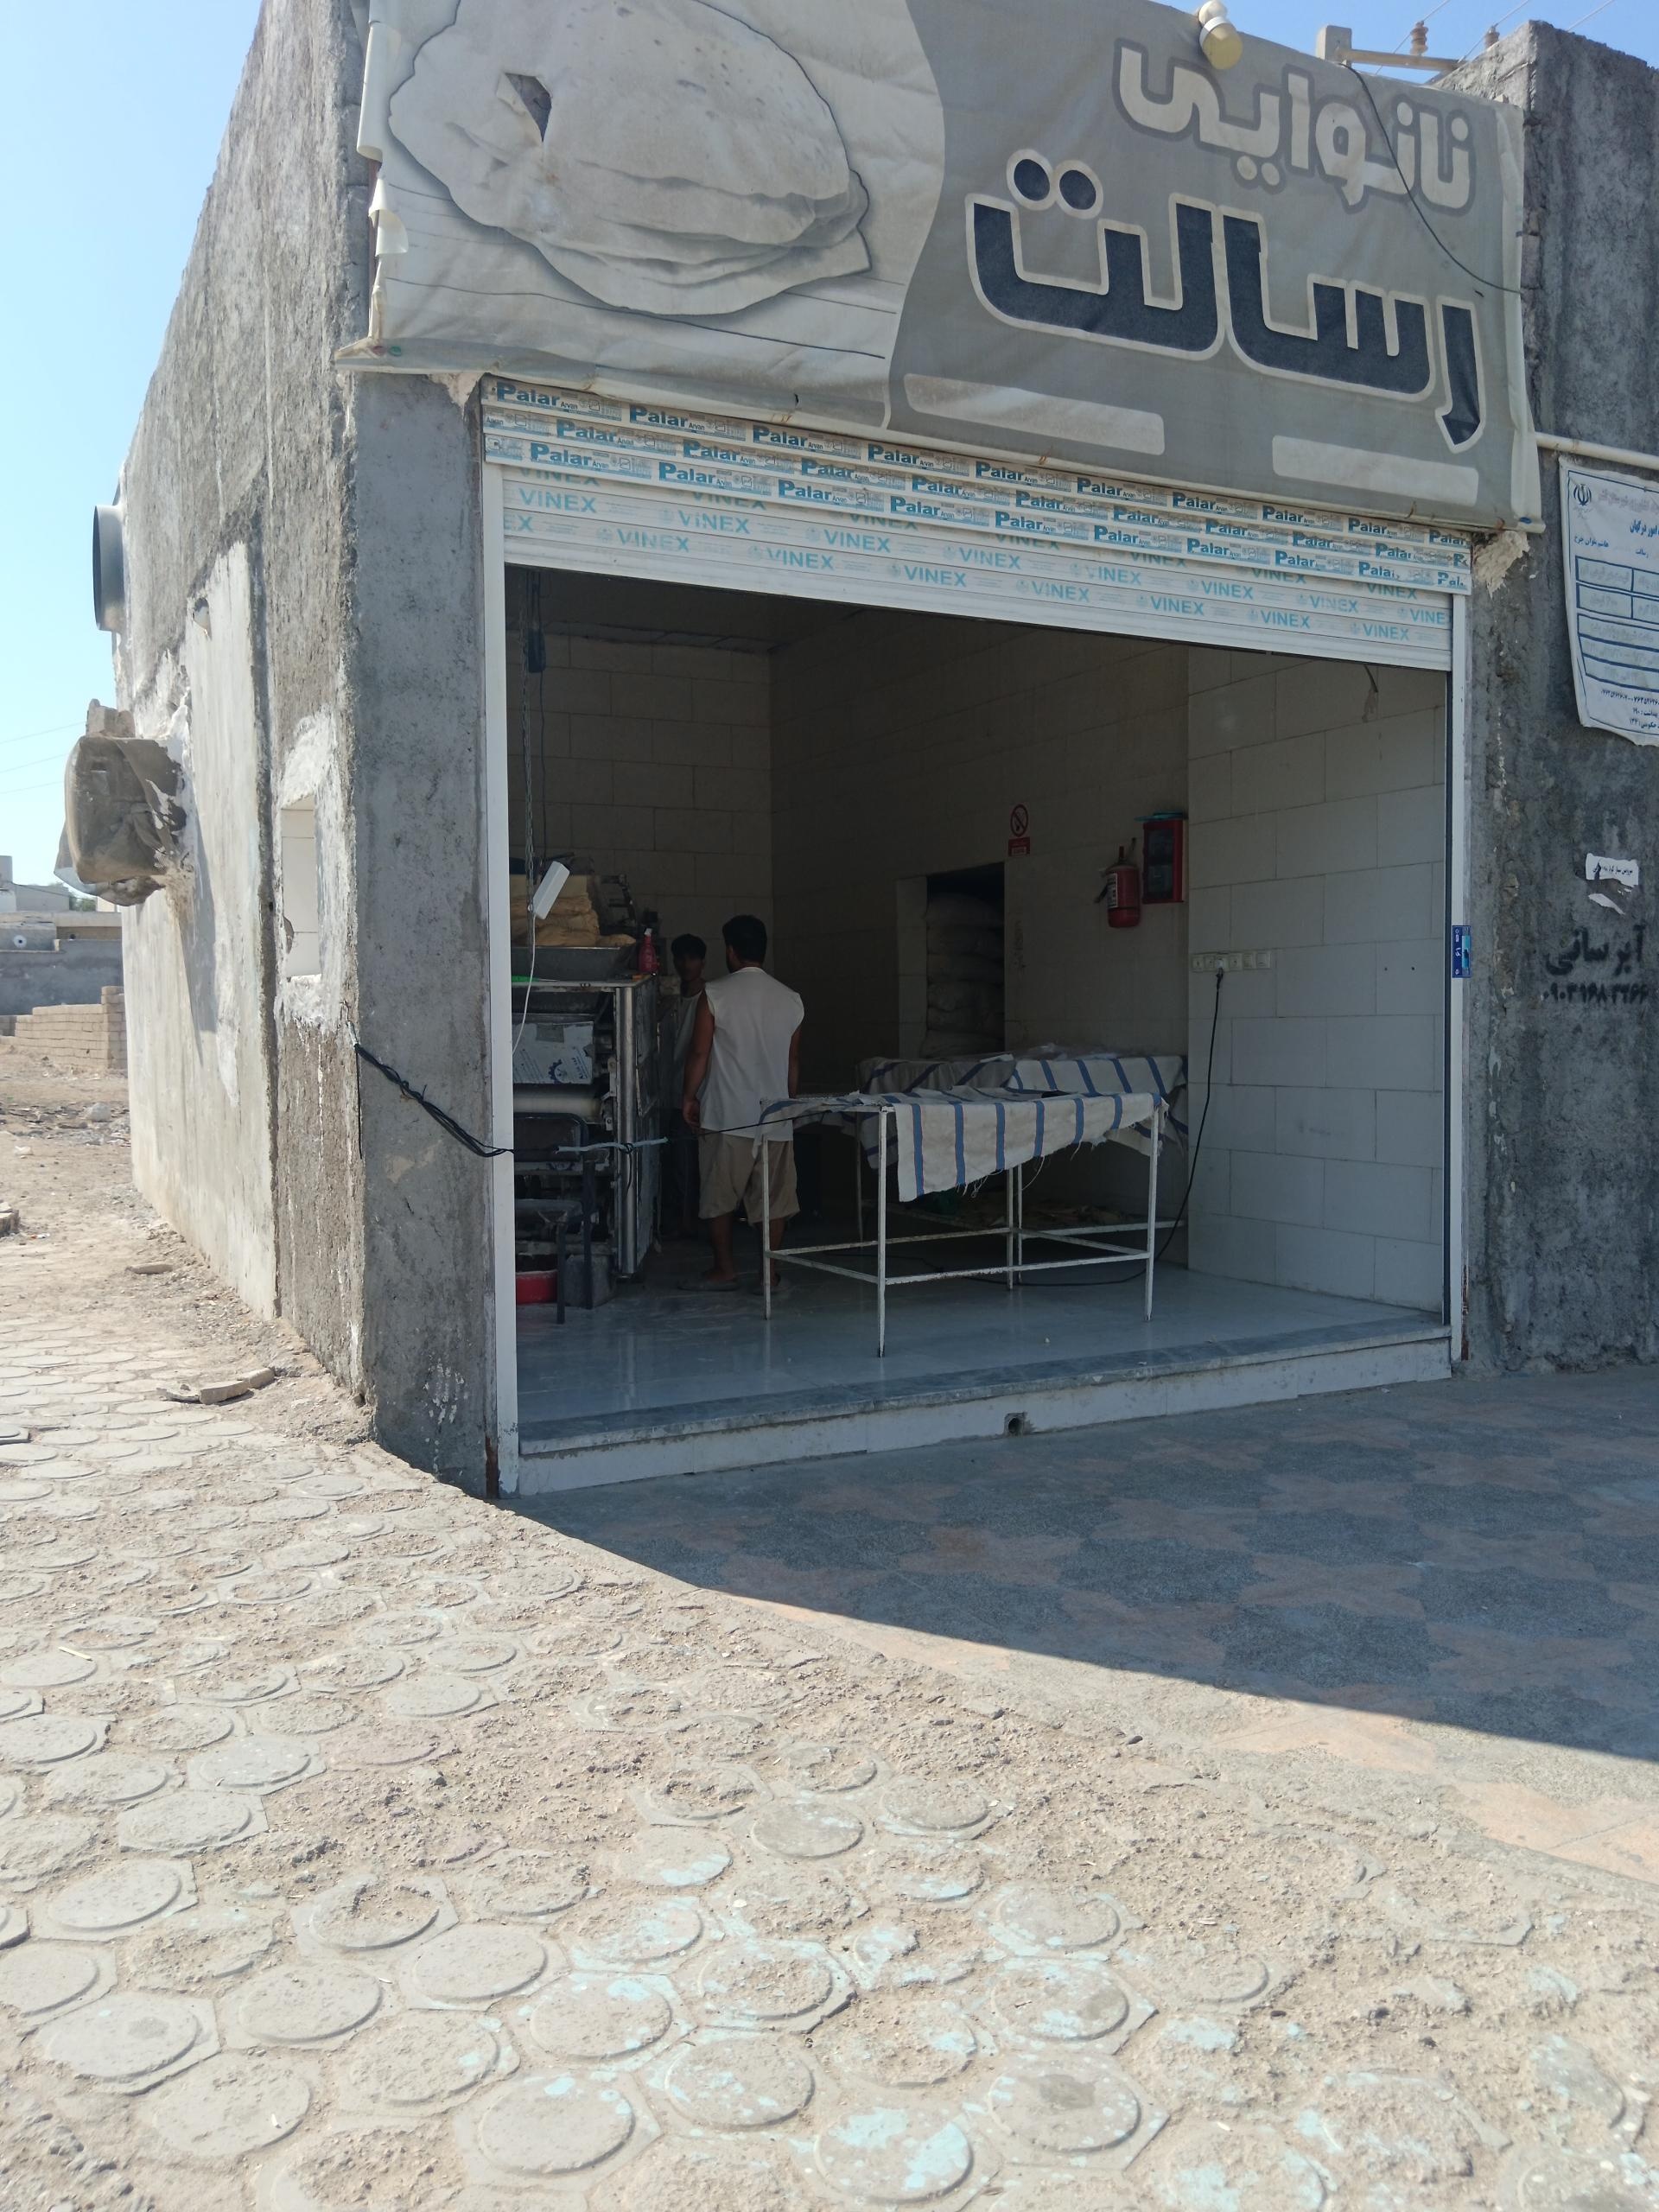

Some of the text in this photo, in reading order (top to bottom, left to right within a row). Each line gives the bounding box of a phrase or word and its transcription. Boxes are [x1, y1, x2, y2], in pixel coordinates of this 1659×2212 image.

[969, 154, 1483, 451] رسالت
[497, 380, 560, 405] Palar
[630, 404, 688, 427] Palar
[753, 425, 808, 446] Palar
[868, 443, 919, 465] Palar
[976, 461, 1024, 480] Palar
[1077, 477, 1122, 496] Palar
[1173, 491, 1215, 510] Palar
[1262, 505, 1303, 522] Palar
[1348, 518, 1387, 534] Palar
[531, 442, 592, 467] Palar
[658, 461, 715, 484] Palar
[779, 479, 831, 500] Palar
[890, 496, 940, 516] Palar
[995, 511, 1043, 531] Palar
[1094, 525, 1138, 544] Palar
[1187, 537, 1229, 555] Palar
[1275, 550, 1315, 567] Palar
[556, 419, 616, 442] Palar
[683, 440, 740, 461] Palar
[802, 458, 855, 479] Palar
[912, 475, 962, 495] Palar
[1016, 490, 1063, 510] Palar
[1206, 518, 1248, 536] Palar
[519, 487, 596, 513] VINEX
[678, 510, 750, 534] VINEX
[824, 529, 891, 553] VINEX
[959, 548, 1021, 570] VINEX
[1201, 581, 1253, 600] VINEX
[617, 529, 690, 552] VINEX
[767, 548, 835, 570] VINEX
[904, 565, 966, 588] VINEX
[1032, 581, 1090, 603] VINEX
[1151, 596, 1205, 615] VINEX
[1261, 610, 1310, 629] VINEX
[1363, 624, 1410, 641] VINEX
